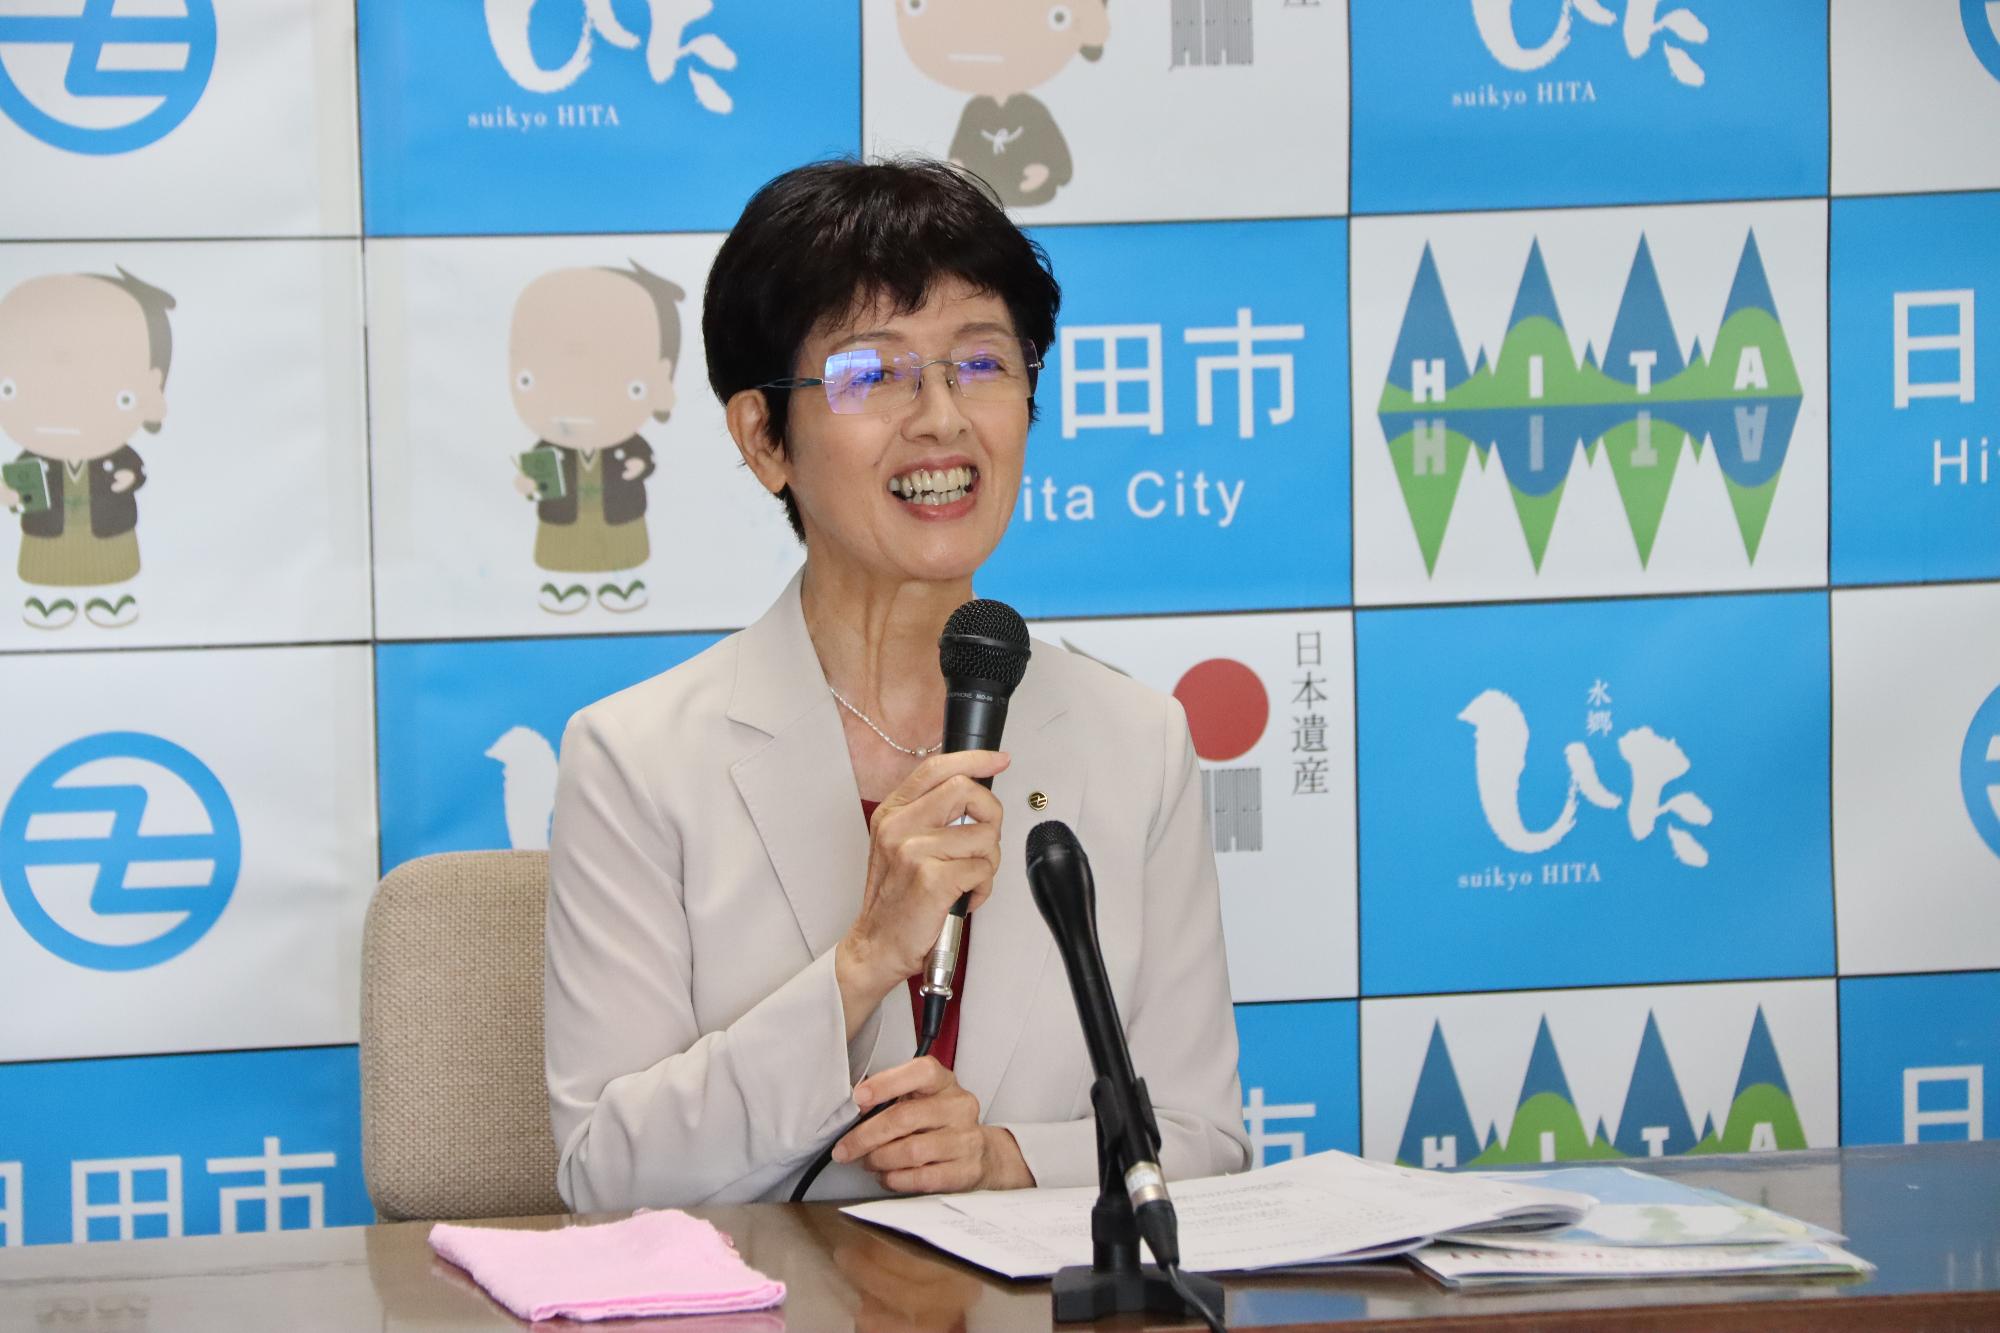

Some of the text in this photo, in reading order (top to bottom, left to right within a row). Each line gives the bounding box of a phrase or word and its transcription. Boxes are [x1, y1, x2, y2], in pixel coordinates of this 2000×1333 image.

[468, 104, 620, 133] suikyo HITA
[1451, 81, 1597, 110] suikyo HITA
[1060, 307, 1305, 439] 田市
[1411, 346, 1769, 404] HITA
[1934, 436, 2000, 486] Hi
[1022, 470, 1245, 528] ita City
[1291, 631, 1329, 796] 日本遺産
[1457, 689, 1713, 868] ひた
[1458, 863, 1602, 891] suikyo HITA
[0, 1136, 336, 1247] 田市
